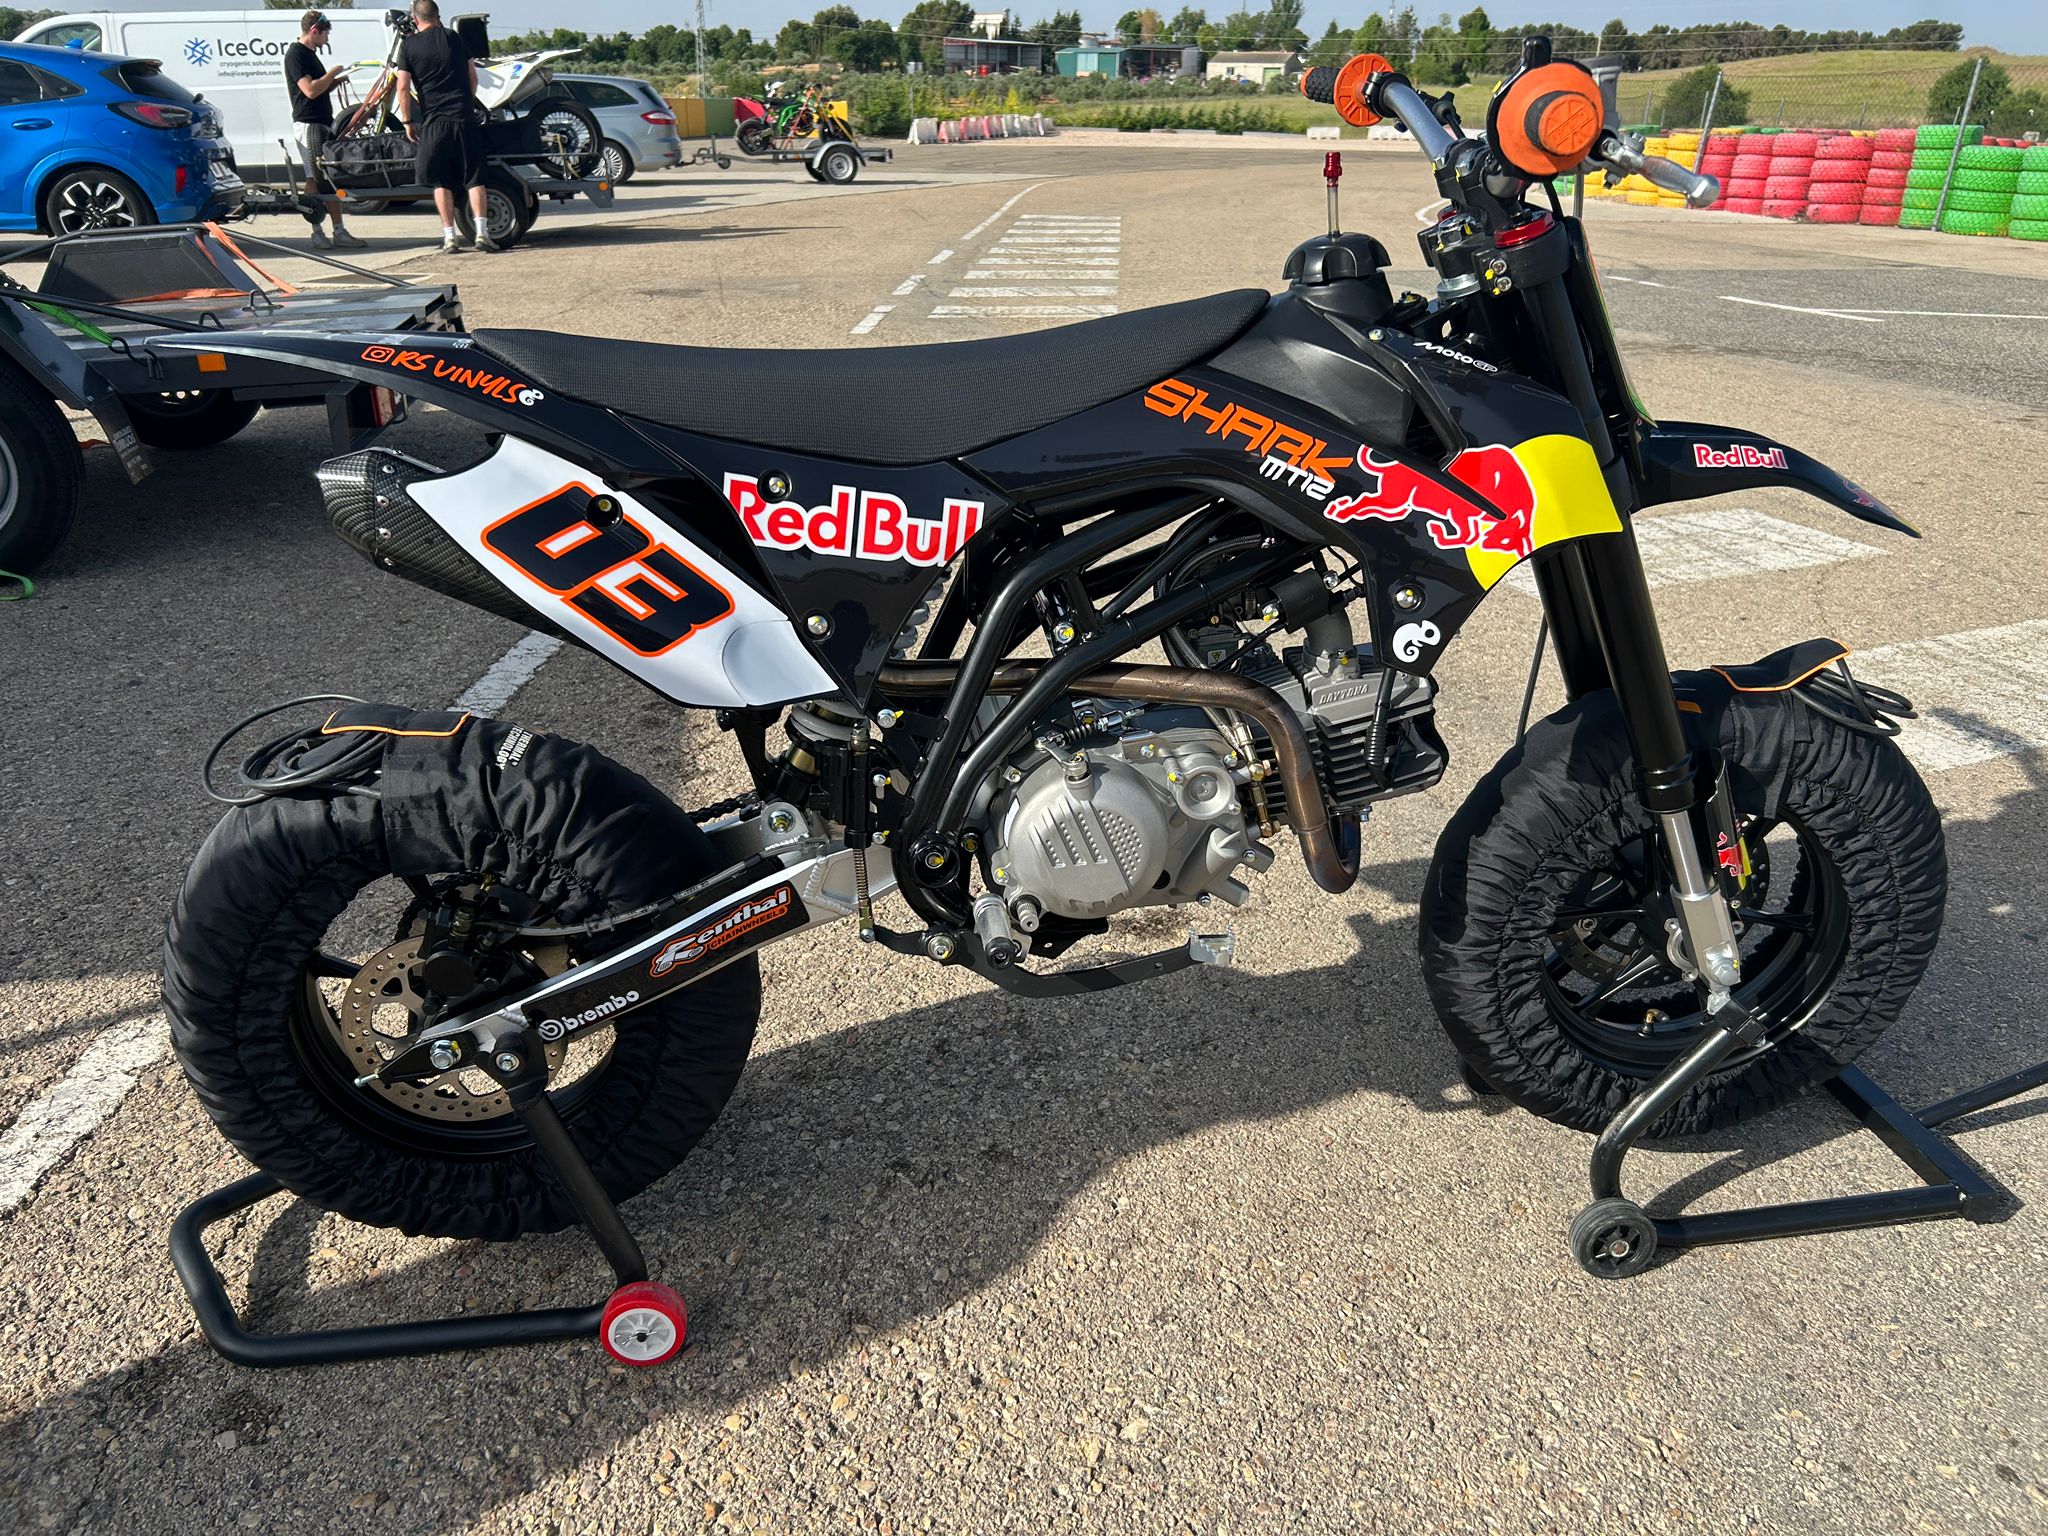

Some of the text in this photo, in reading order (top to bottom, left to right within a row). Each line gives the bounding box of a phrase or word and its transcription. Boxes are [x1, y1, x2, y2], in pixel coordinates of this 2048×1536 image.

[217, 37, 332, 56] IceGorn
[220, 59, 281, 68] cryogenic solutions
[391, 350, 527, 404] RS VINYLS
[1413, 341, 1498, 372] MotoGP
[1143, 378, 1353, 484] SHARK
[1693, 444, 1789, 470] Red Bull
[1259, 455, 1335, 501] MT12
[723, 473, 984, 567] Red Bull
[481, 480, 735, 657] 03
[1319, 684, 1369, 705] DAYTONA
[654, 890, 788, 974] Renthal
[711, 907, 786, 948] CHAINWHEELS
[561, 990, 639, 1031] brembo
